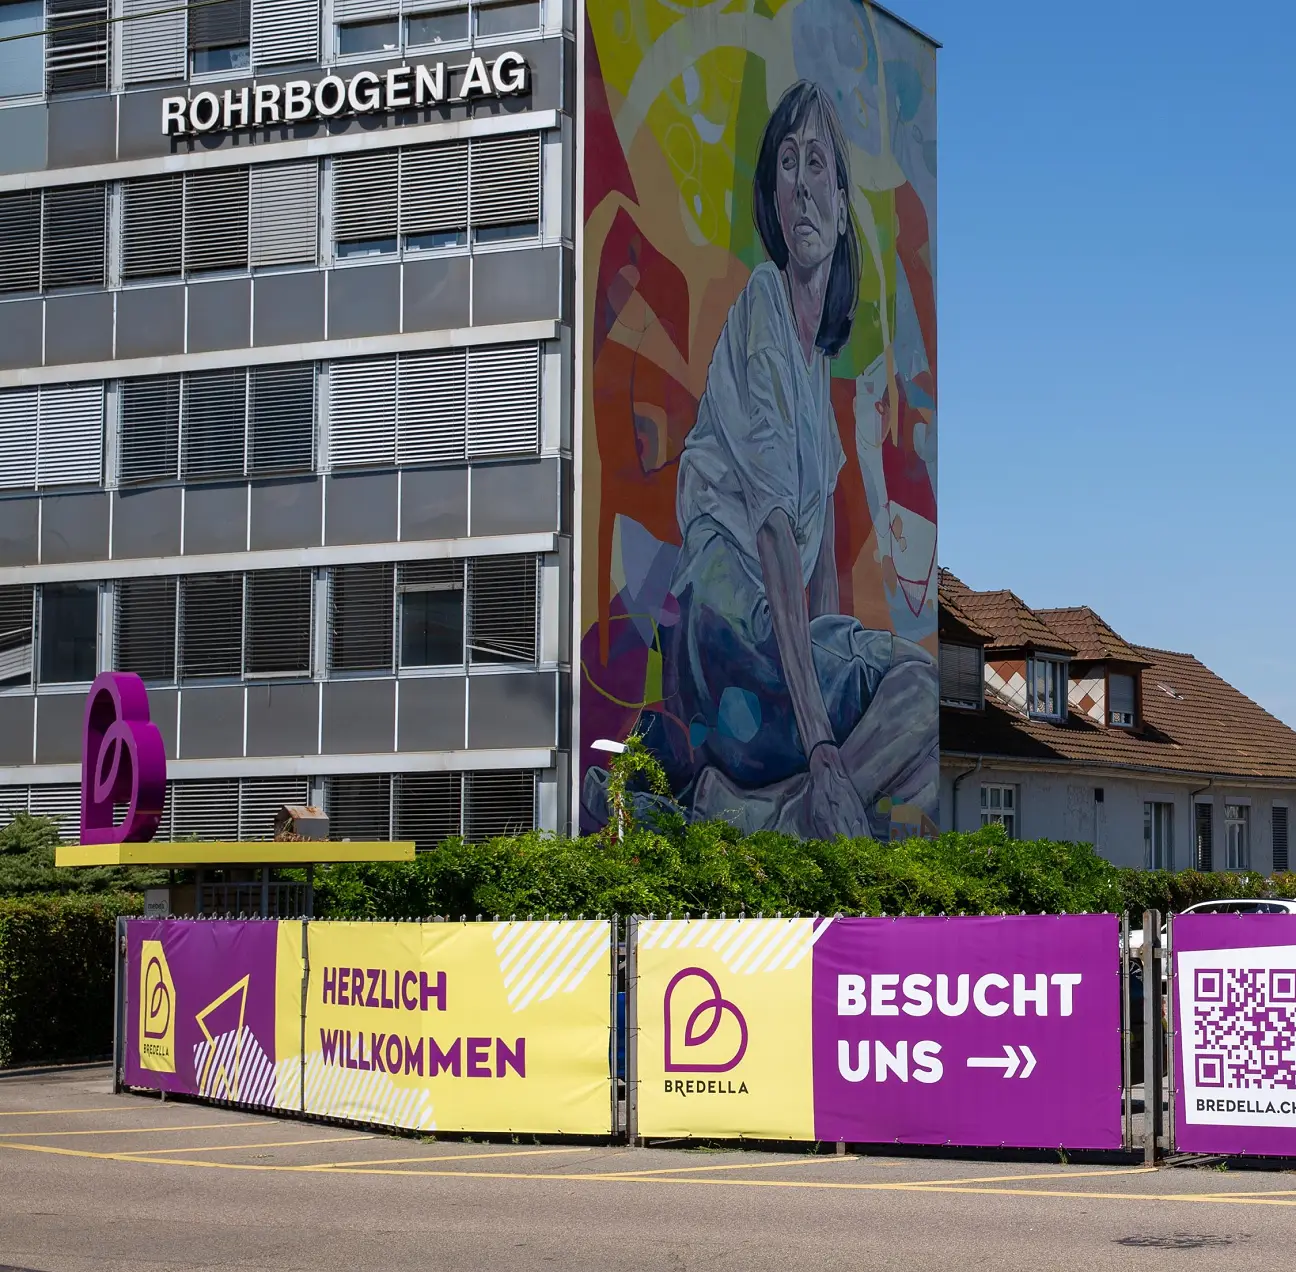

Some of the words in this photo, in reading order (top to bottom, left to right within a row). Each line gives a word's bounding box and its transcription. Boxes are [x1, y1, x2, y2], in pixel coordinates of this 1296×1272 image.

[161, 61, 448, 136] ROHRBOGEN
[459, 51, 530, 99] AG
[322, 966, 447, 1012] HERZLICH
[837, 973, 1082, 1017] BESUCHT
[143, 1043, 170, 1057] BREDELLA
[319, 1027, 526, 1079] WILLKOMMEN
[837, 1039, 944, 1084] UNS
[664, 1079, 749, 1098] BREDELLA
